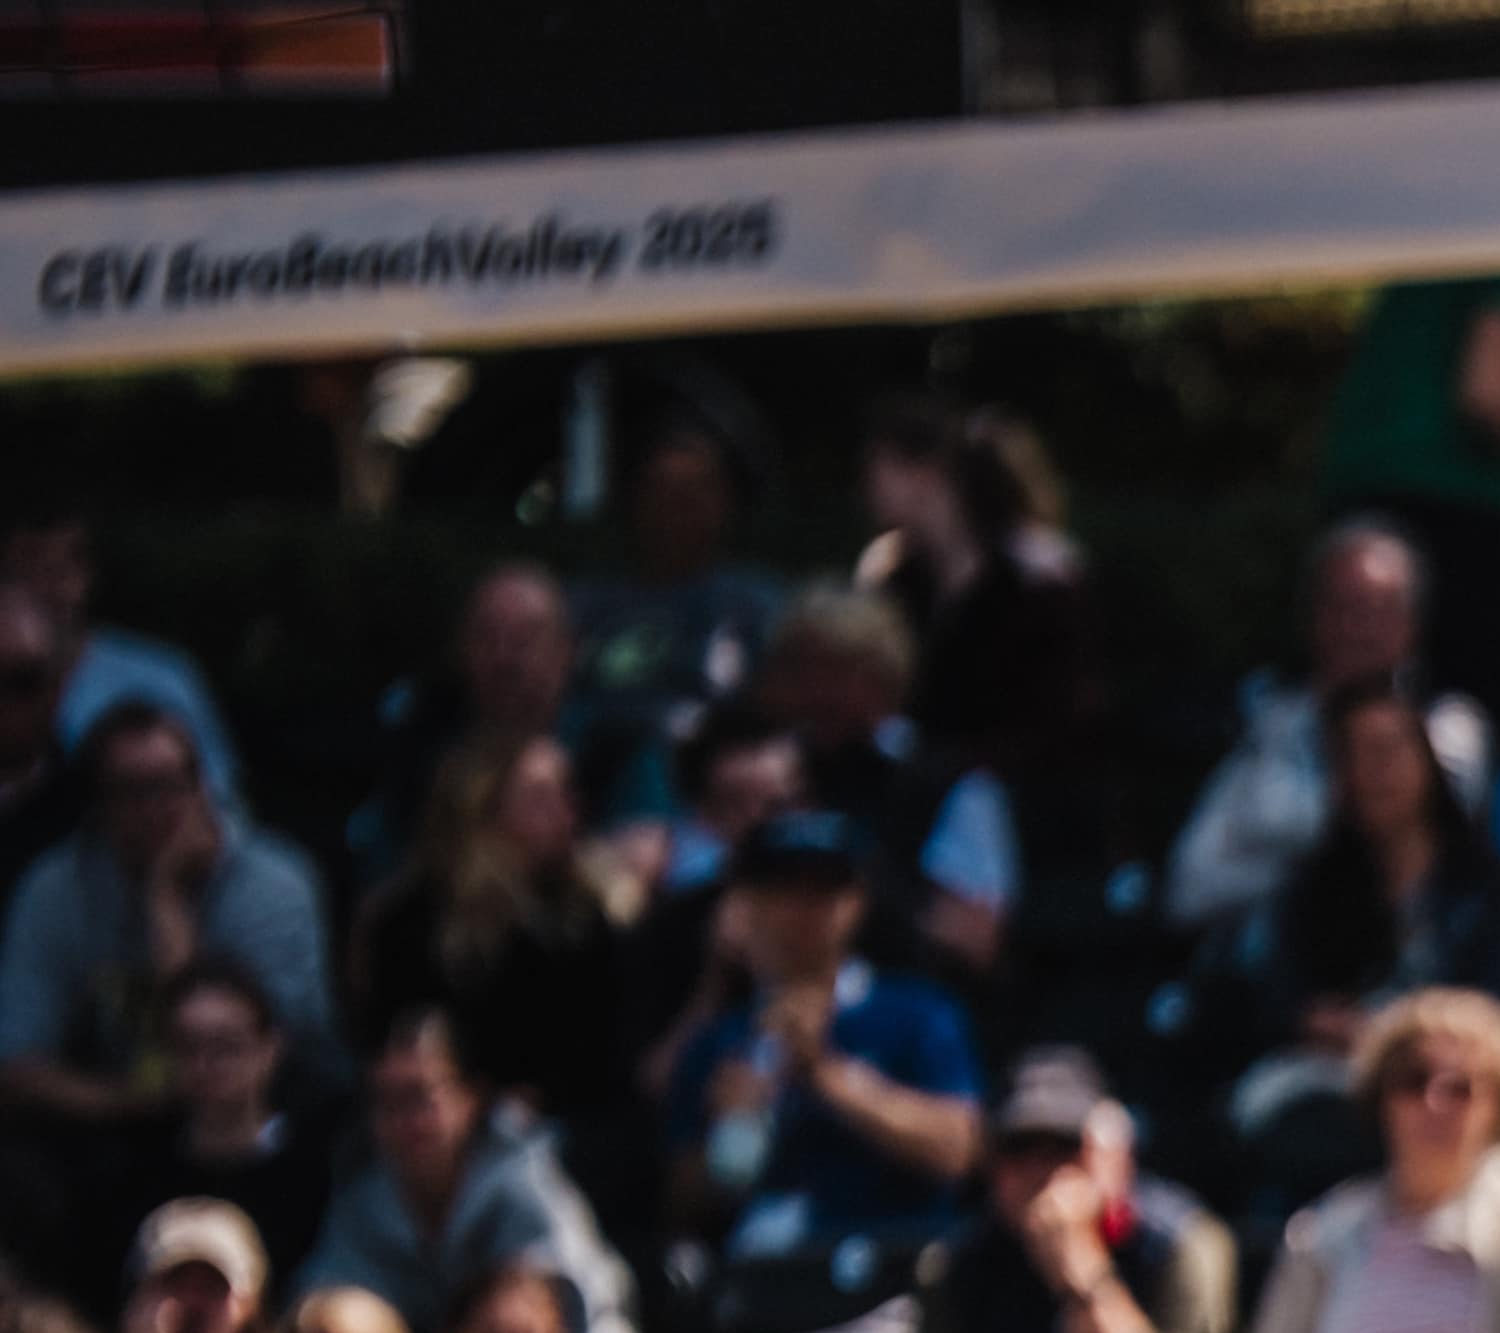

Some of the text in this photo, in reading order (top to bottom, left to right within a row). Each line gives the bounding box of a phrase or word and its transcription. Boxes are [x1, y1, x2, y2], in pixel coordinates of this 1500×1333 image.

[38, 199, 780, 318] CEV EuroBeachVolley 2025
